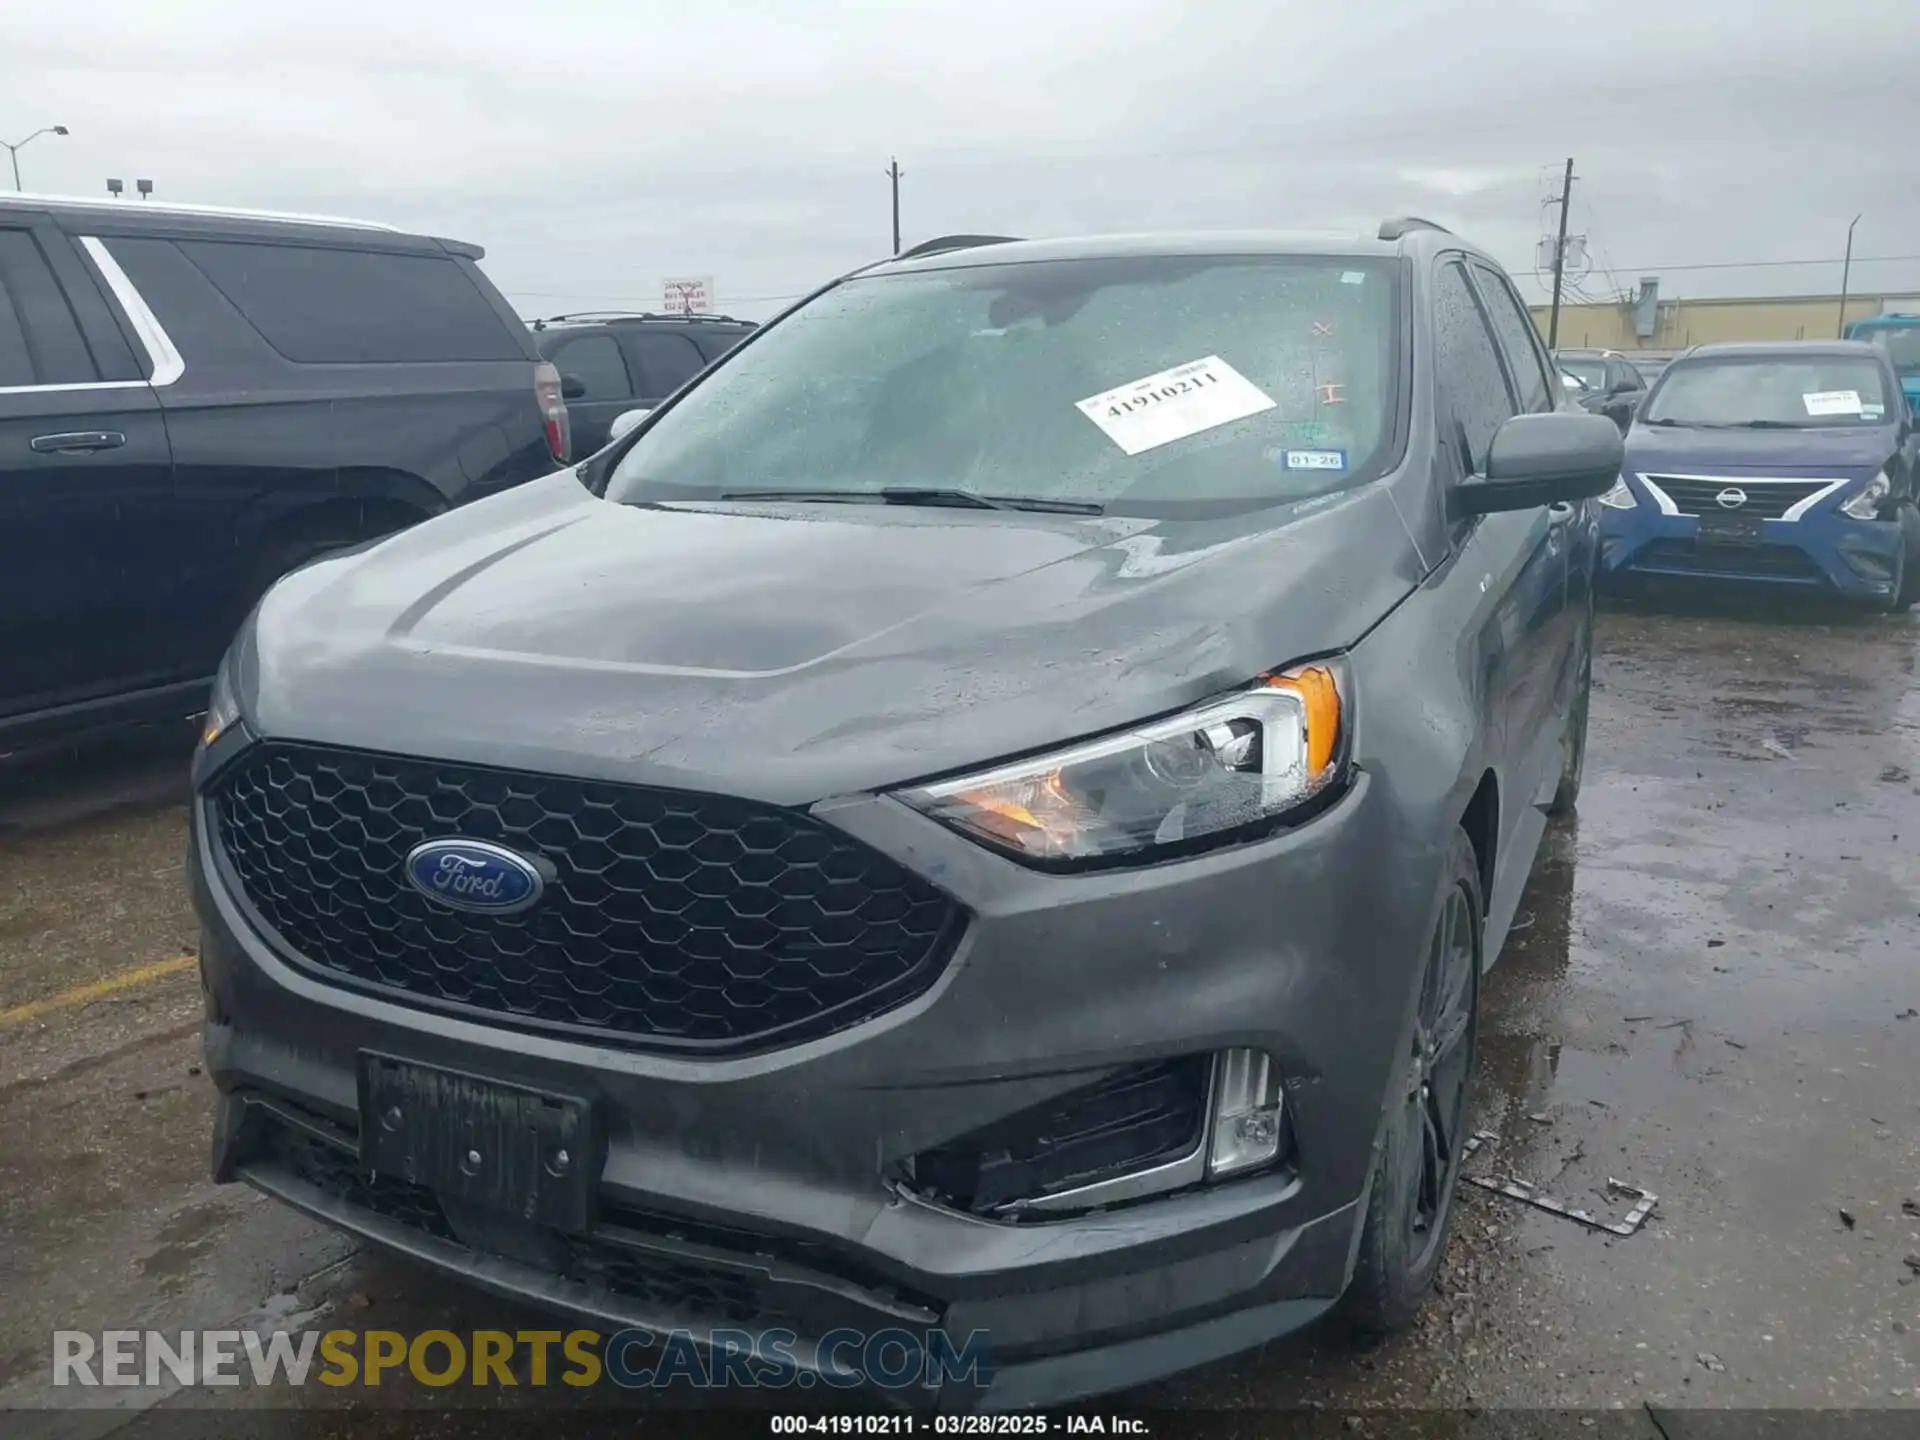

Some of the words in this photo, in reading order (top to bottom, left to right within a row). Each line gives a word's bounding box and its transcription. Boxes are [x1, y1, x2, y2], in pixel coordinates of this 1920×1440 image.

[1107, 372, 1219, 418] 41910211
[1291, 455, 1340, 466] 01-26
[433, 853, 504, 899] Ford
